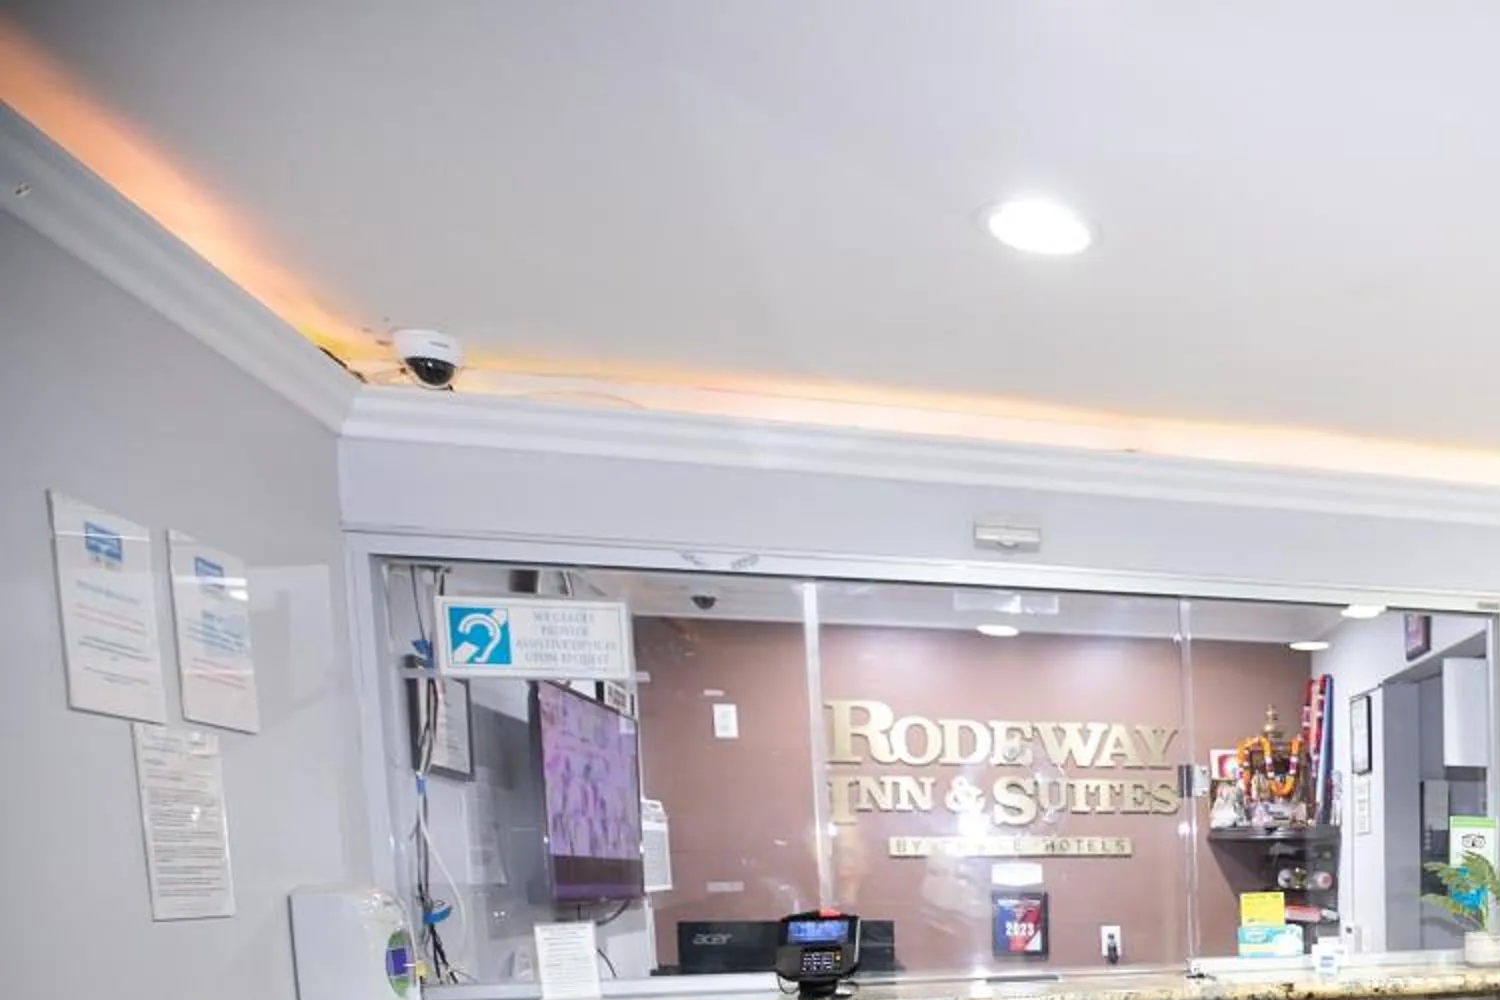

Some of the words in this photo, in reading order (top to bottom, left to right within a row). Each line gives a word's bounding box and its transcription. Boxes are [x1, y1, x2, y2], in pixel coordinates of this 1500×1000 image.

[825, 700, 1179, 769] RODEWAY
[828, 775, 936, 825] INN
[945, 776, 984, 812] &
[992, 775, 1180, 825] SUITES
[1043, 838, 1127, 853] HOTELS
[1004, 921, 1036, 937] 2023
[692, 933, 733, 946] acer
